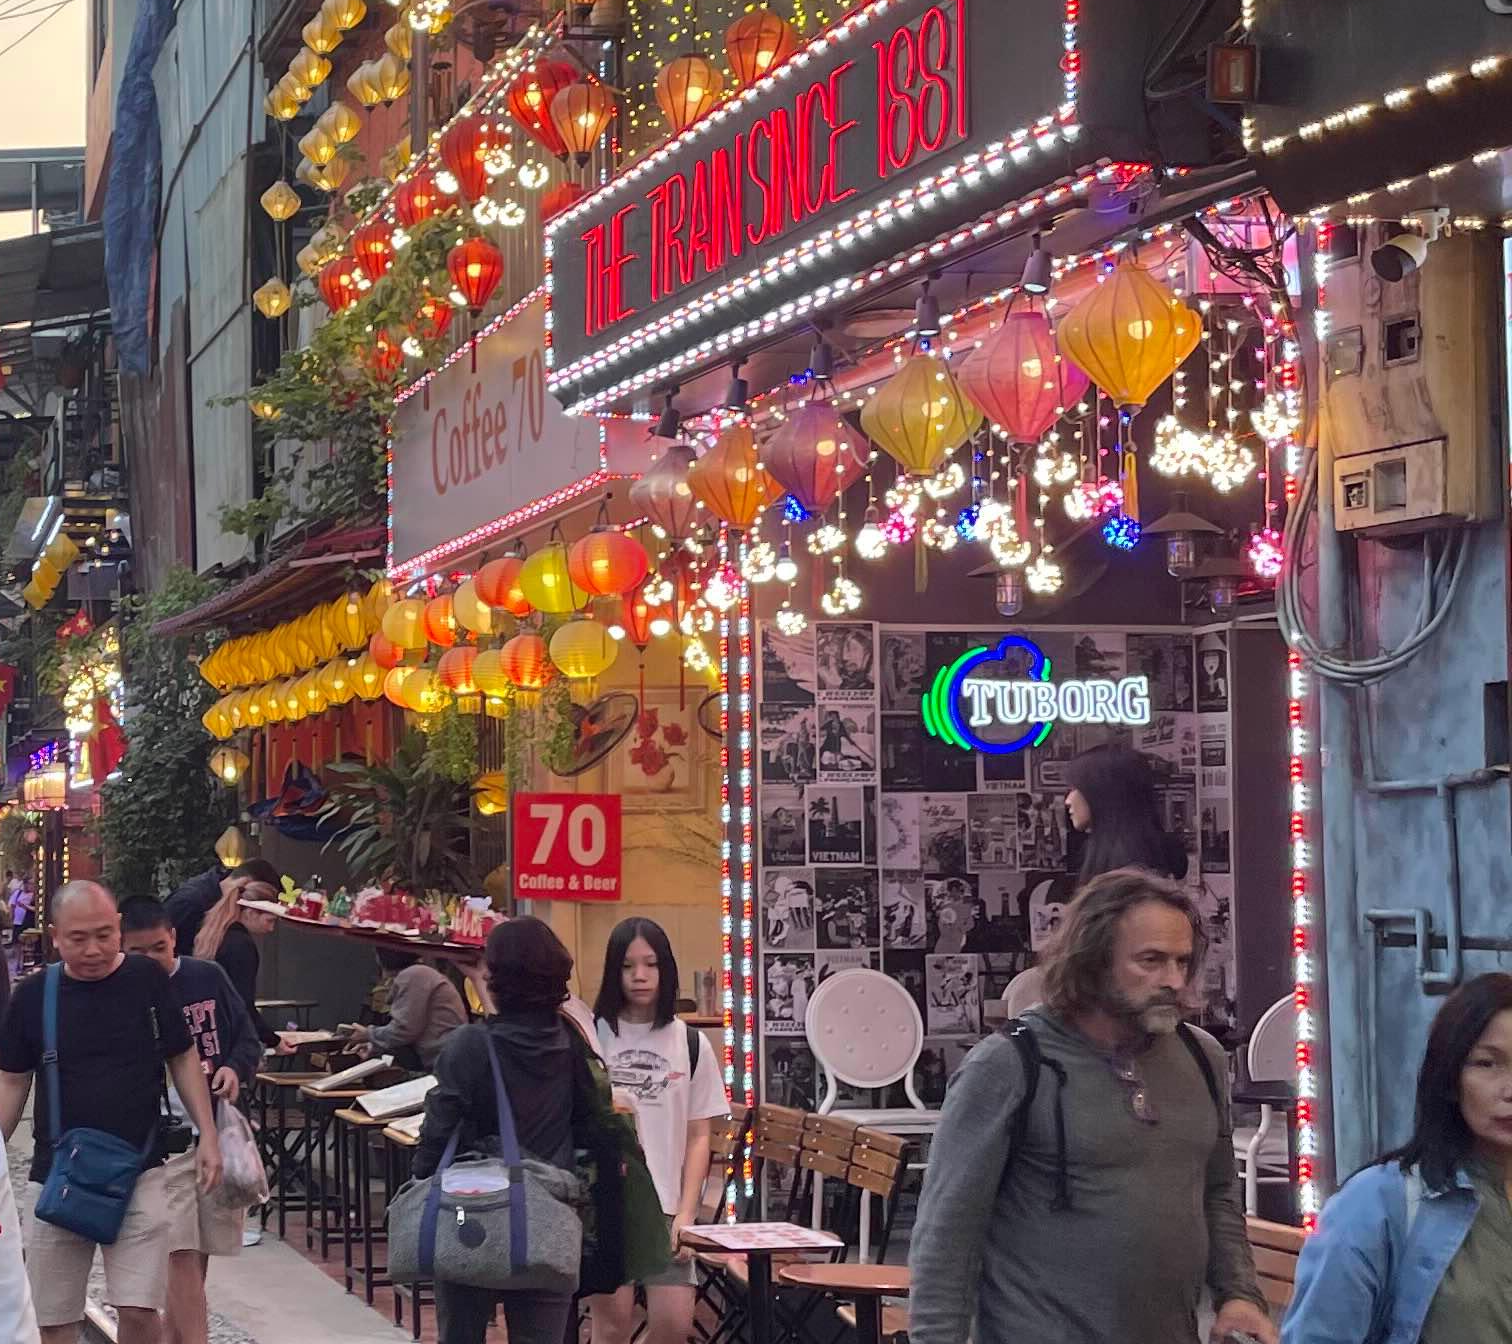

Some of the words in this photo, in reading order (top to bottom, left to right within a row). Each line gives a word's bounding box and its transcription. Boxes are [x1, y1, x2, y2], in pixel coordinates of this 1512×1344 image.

[580, 203, 639, 337] THE
[646, 133, 743, 303] TRAIN
[747, 59, 858, 246] SINCE
[431, 382, 508, 497] Coffee
[512, 347, 545, 452] 70
[961, 674, 1152, 728] TUBORG
[529, 803, 607, 867] 70
[811, 850, 860, 862] VIETNAM
[519, 873, 565, 890] Coffee
[567, 873, 580, 891] &
[583, 874, 617, 892] Beer
